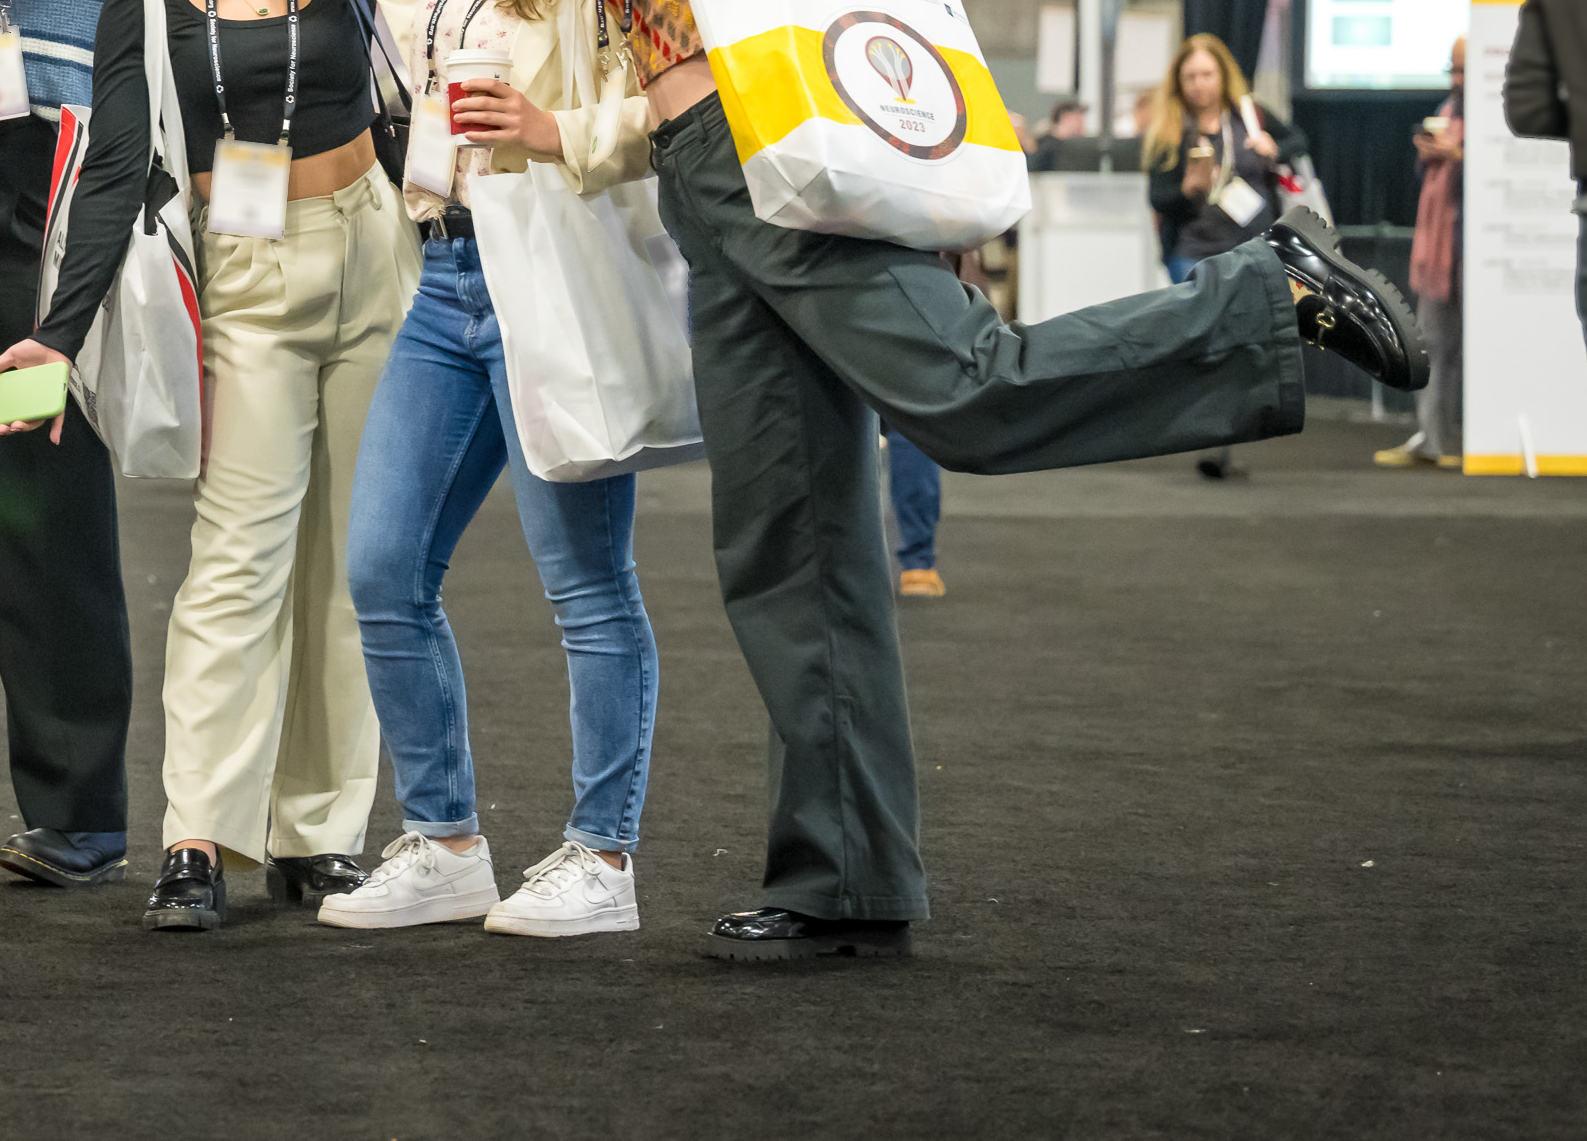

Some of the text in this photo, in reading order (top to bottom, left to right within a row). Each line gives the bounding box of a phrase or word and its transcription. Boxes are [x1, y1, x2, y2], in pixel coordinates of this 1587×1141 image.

[209, 18, 217, 36] Society
[212, 43, 222, 82] Neuroscience
[287, 70, 297, 93] Society
[879, 104, 936, 121] NEUROSCIENCE
[899, 119, 926, 133] 2023
